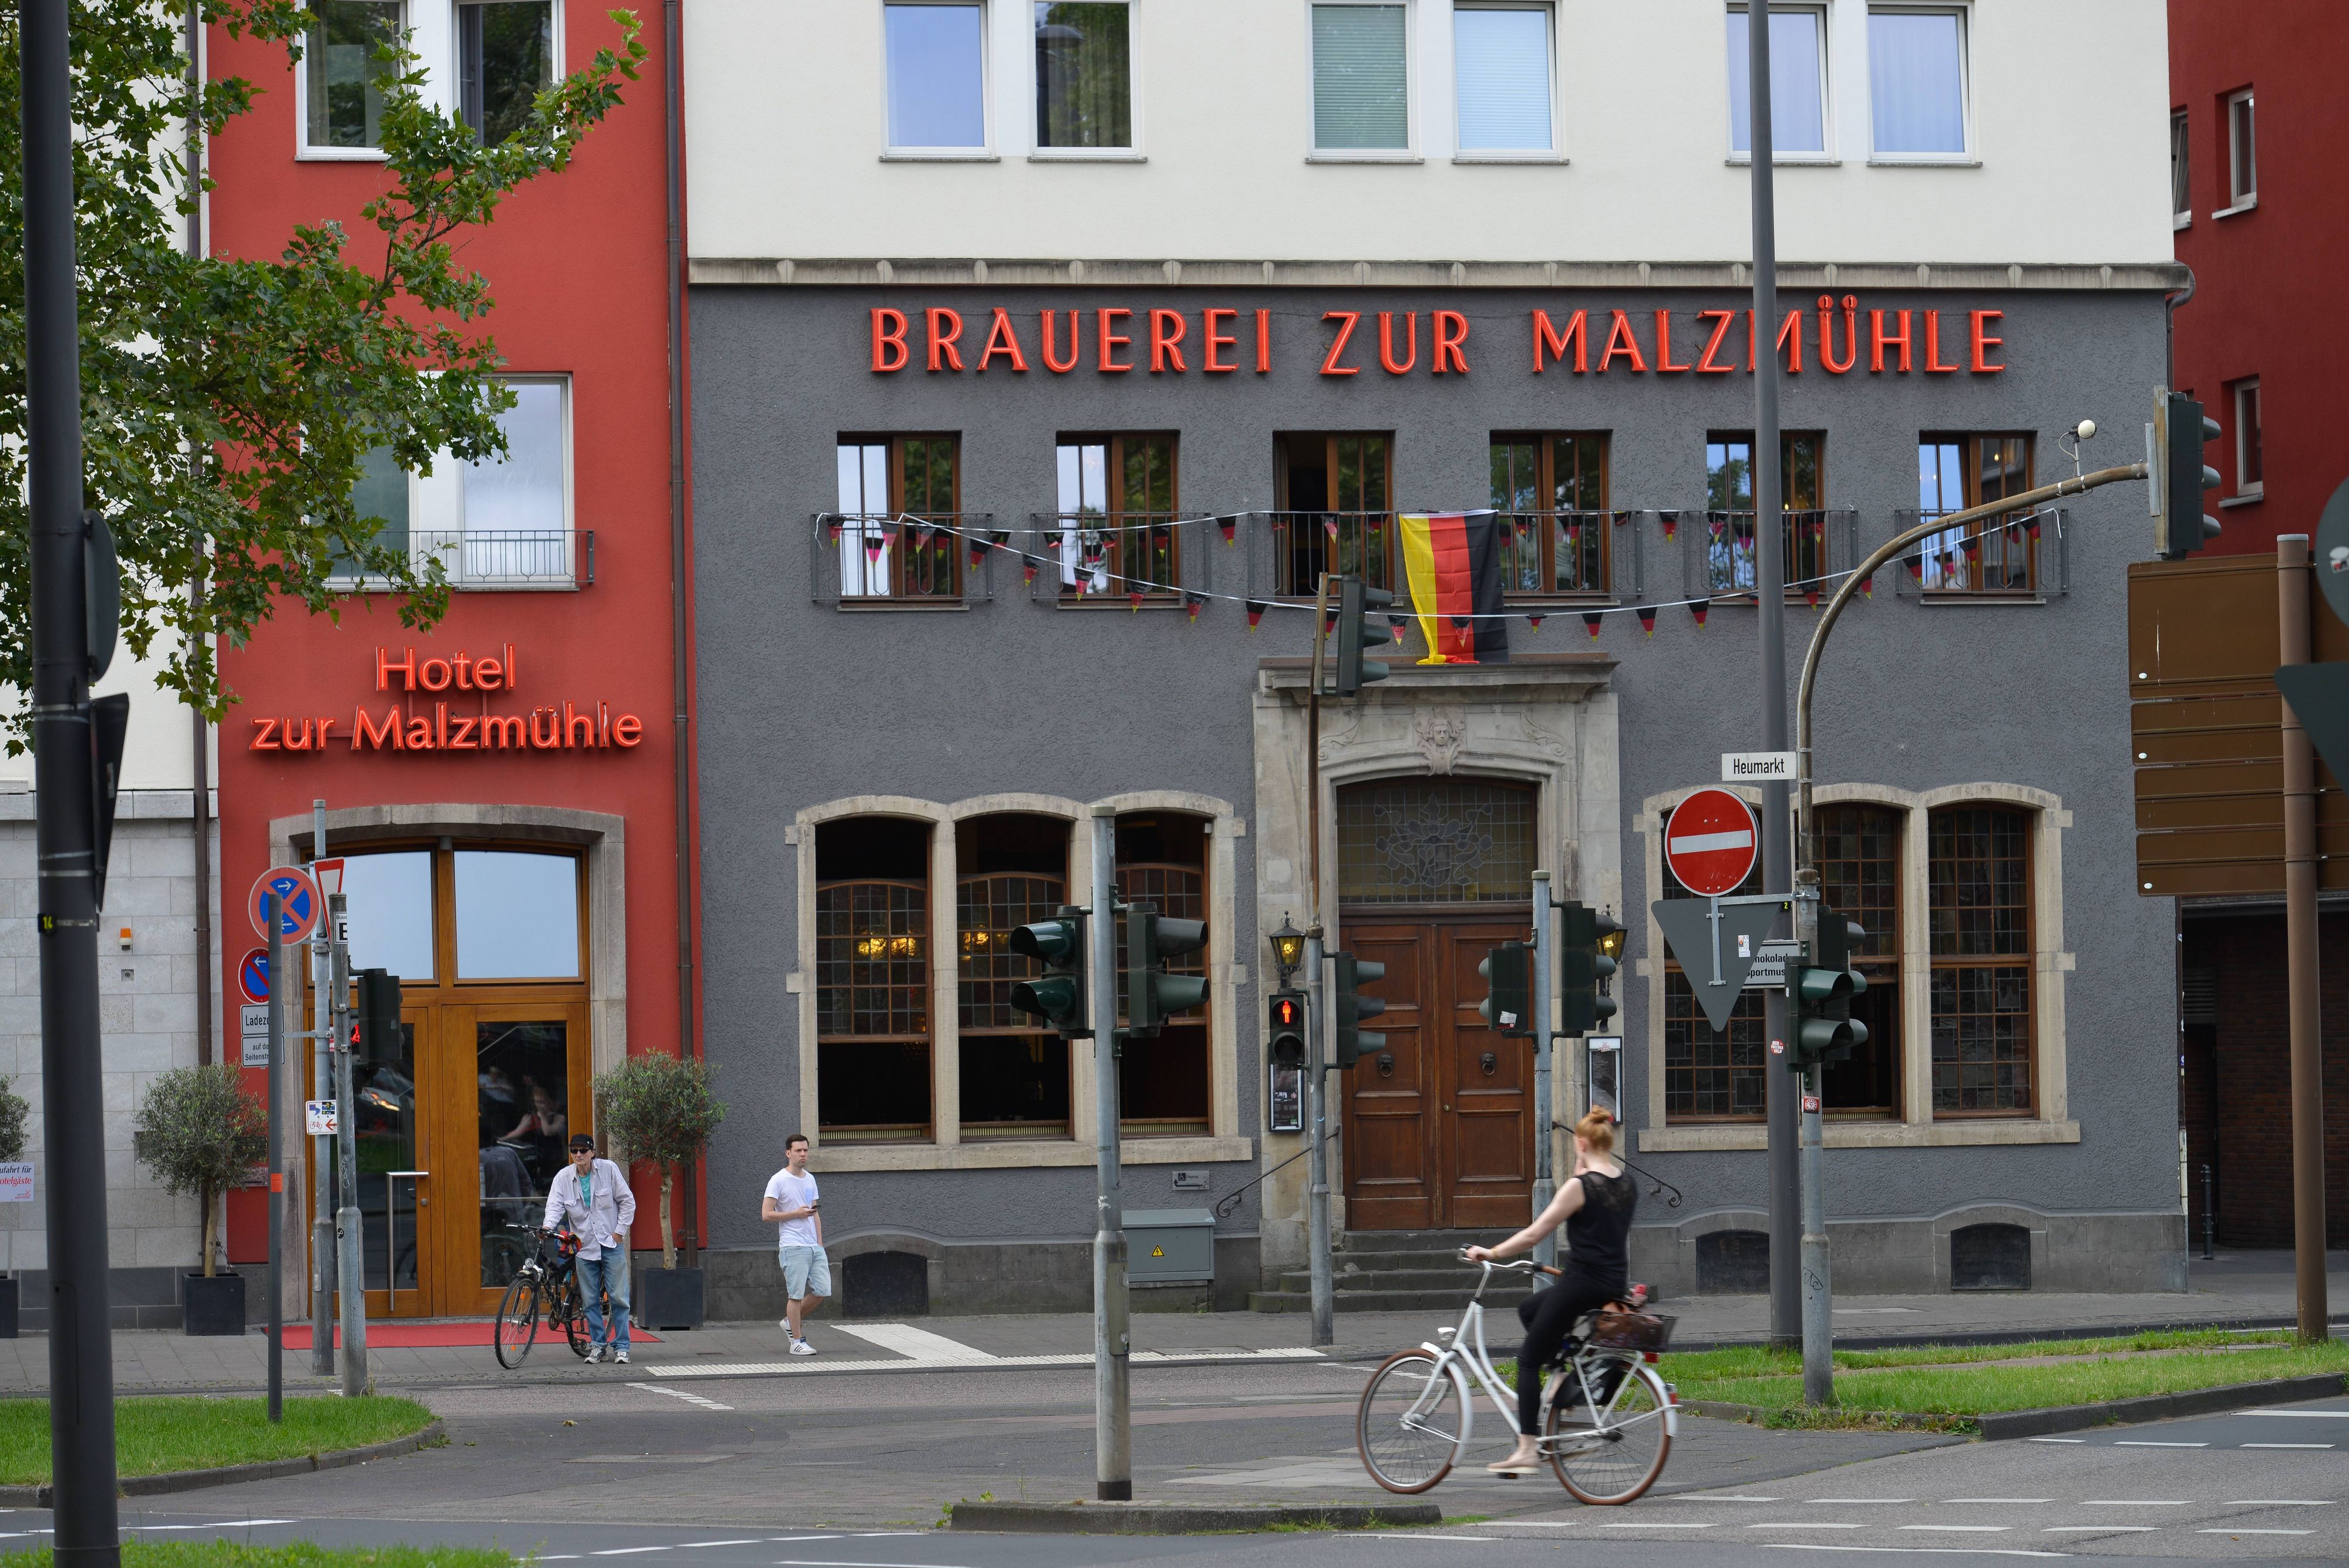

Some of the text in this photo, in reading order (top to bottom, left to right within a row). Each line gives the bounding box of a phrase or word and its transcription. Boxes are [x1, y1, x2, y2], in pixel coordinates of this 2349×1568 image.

[870, 295, 2007, 374] BRAUEREI ZUR MALZMÜHLE
[376, 643, 516, 691] Hotel
[249, 700, 643, 751] zur Malzmühle
[1734, 758, 1785, 774] Heumarkt
[1747, 968, 1786, 979] portmus
[245, 1014, 270, 1027] Ladez
[245, 1053, 269, 1061] Seitenstr
[0, 1176, 32, 1187] otelgäste
